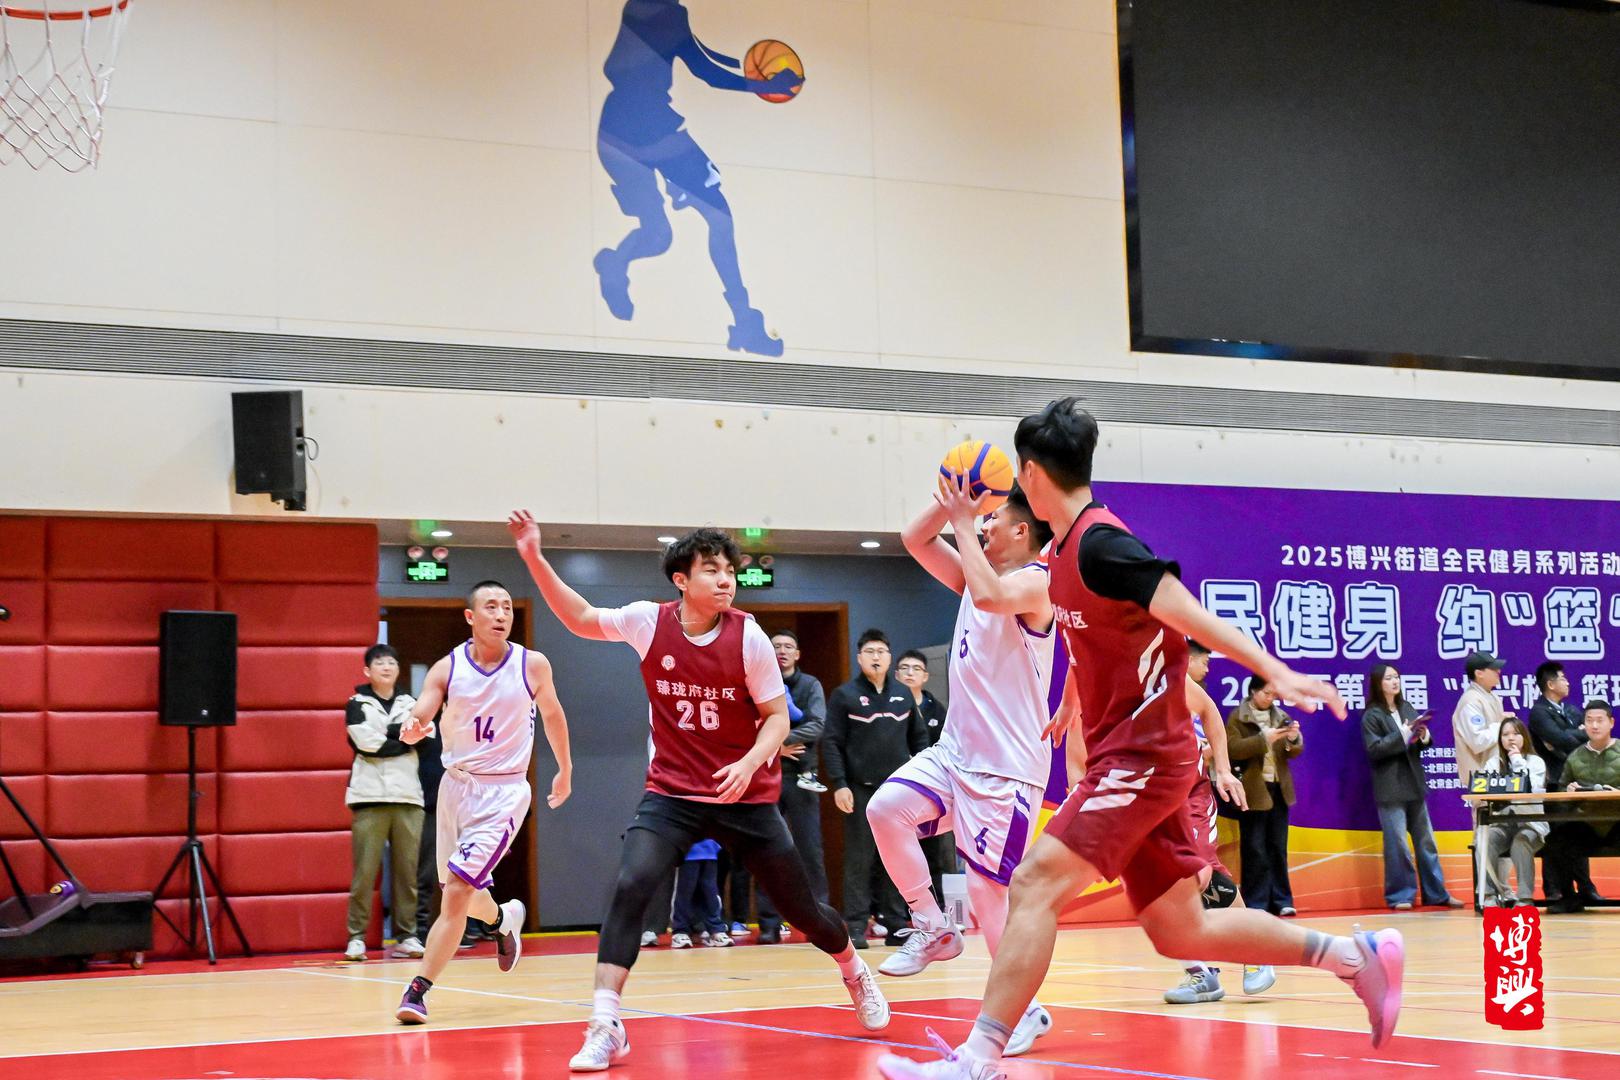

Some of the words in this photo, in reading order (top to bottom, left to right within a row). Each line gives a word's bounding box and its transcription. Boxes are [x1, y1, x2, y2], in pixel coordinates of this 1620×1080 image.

[1281, 544, 1620, 576] 2025博兴街道全民健身系列活动
[474, 716, 494, 743] 14
[676, 700, 719, 731] 26
[1473, 777, 1487, 793] 2
[1511, 777, 1521, 792] 1
[975, 827, 989, 855] 6
